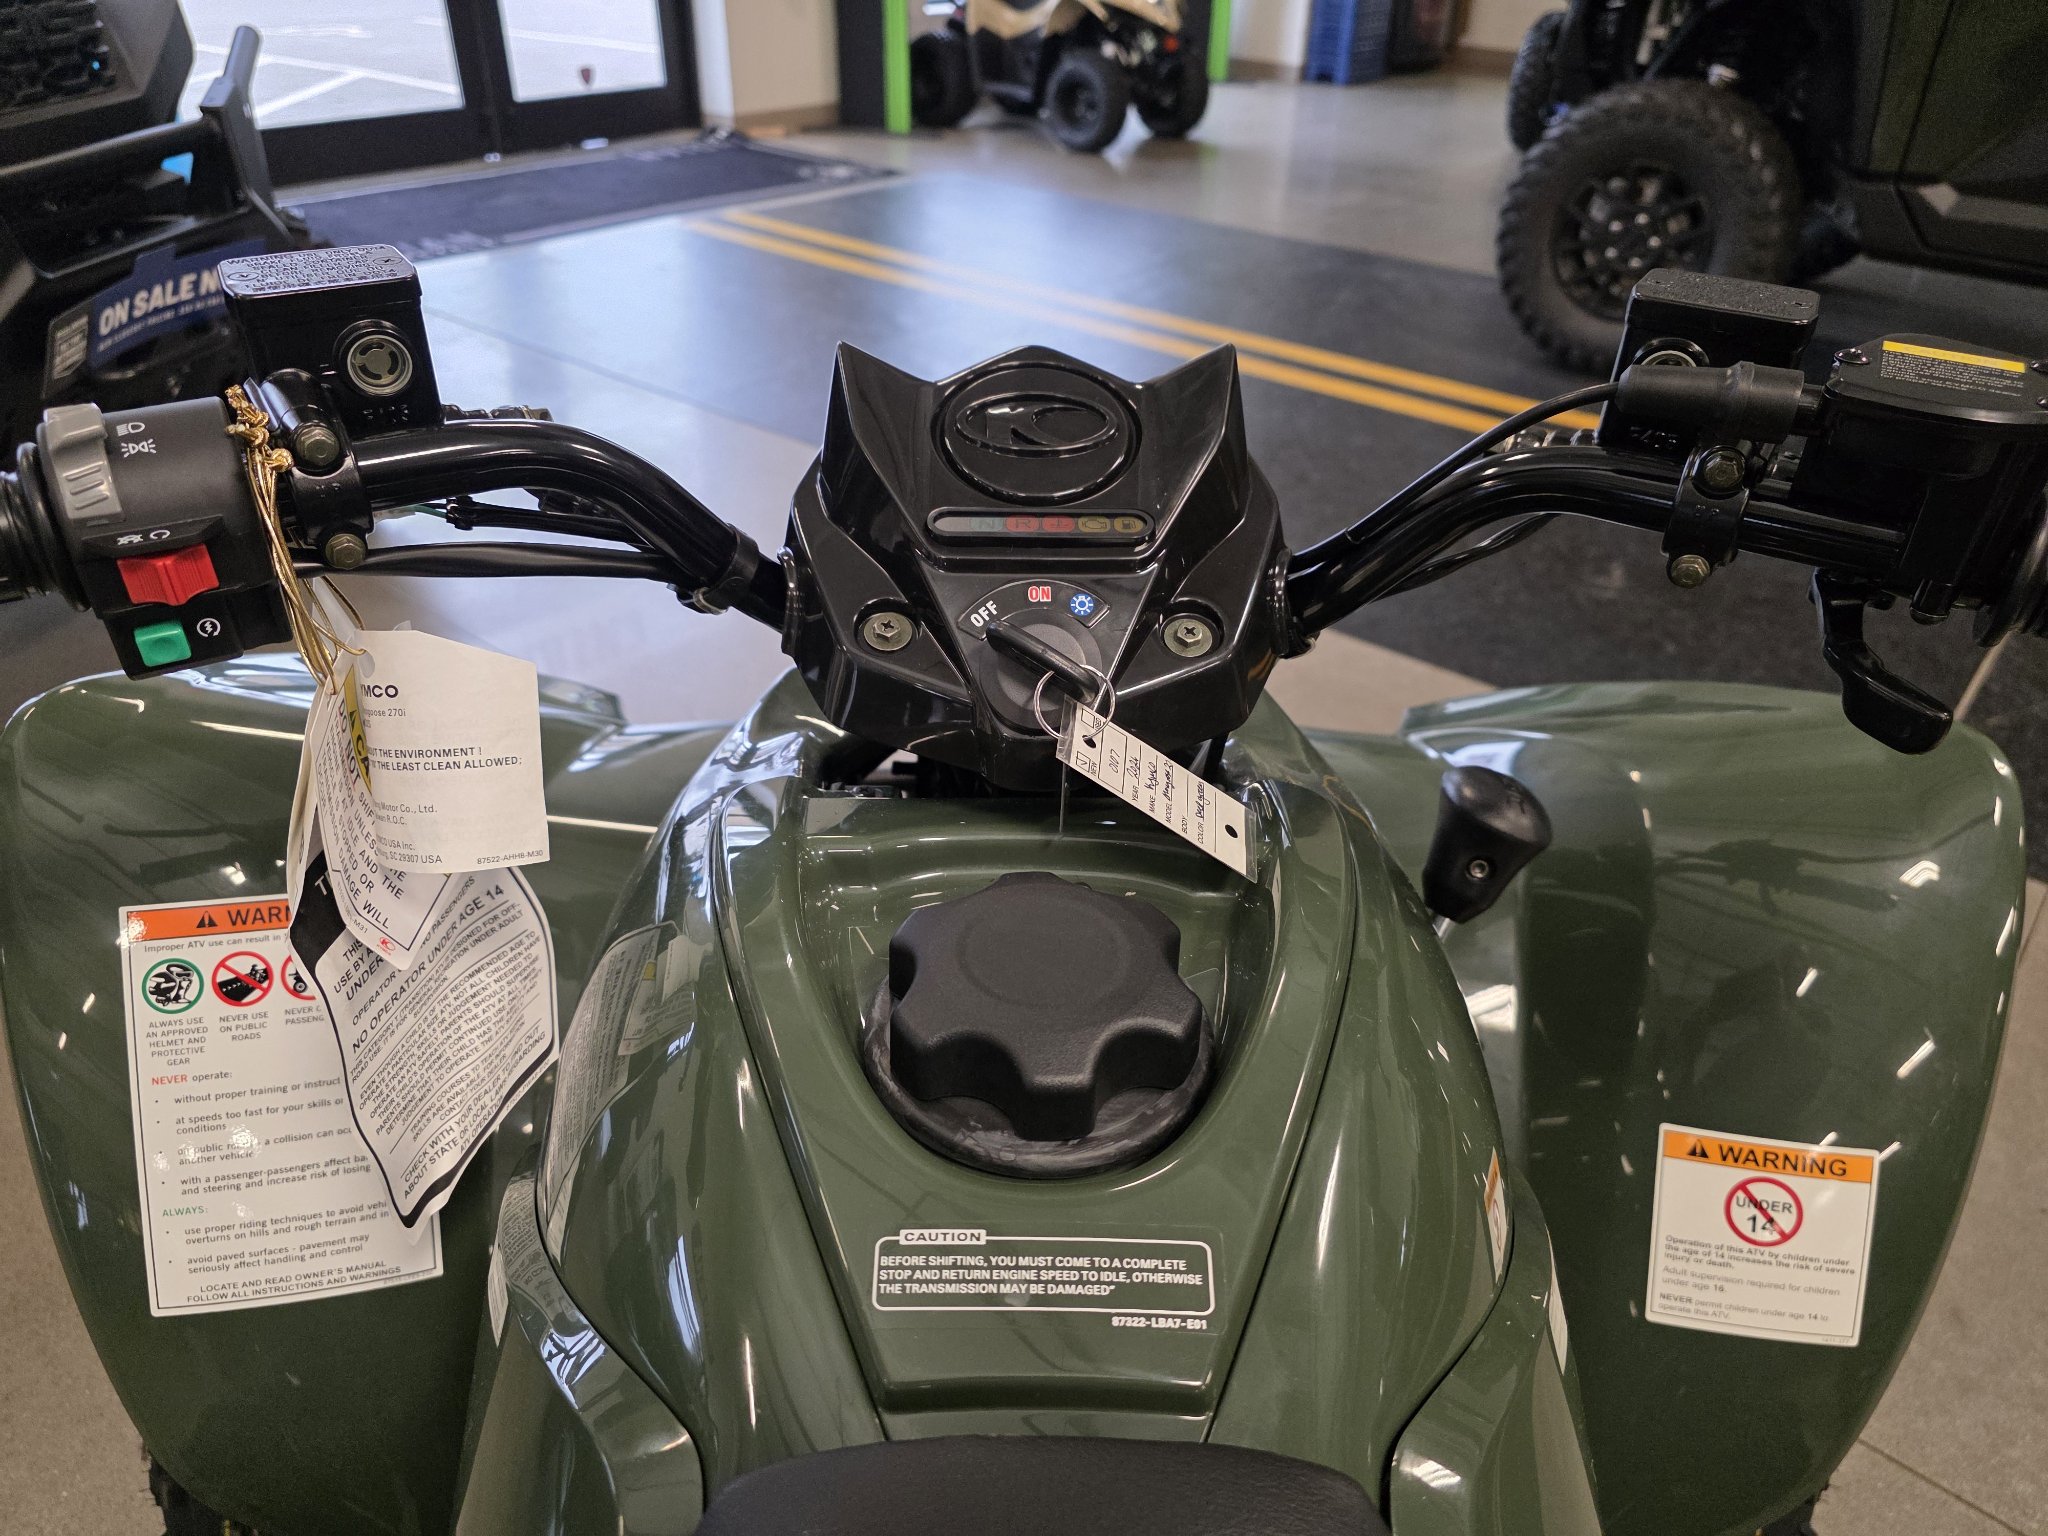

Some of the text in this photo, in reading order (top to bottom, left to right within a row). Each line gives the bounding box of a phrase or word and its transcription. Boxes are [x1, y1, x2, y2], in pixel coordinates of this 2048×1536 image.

[99, 298, 130, 336] ON
[133, 272, 197, 318] SALE
[1014, 518, 1031, 529] R
[1028, 586, 1051, 602] ON
[970, 600, 998, 627] OFF
[388, 709, 406, 717] 270i
[379, 749, 393, 758] THE
[395, 747, 475, 759] ENVIRONMENT
[378, 761, 390, 770] THE
[392, 762, 421, 771] LEAST
[423, 761, 460, 770] CLEAN
[400, 804, 416, 814] Co.,
[419, 804, 437, 813] Ltd.
[389, 839, 400, 848] USA
[422, 855, 442, 863] USA
[359, 851, 404, 899] AND THE
[360, 873, 375, 894] OR
[363, 900, 389, 929] WILL
[144, 943, 184, 952] Improper
[187, 940, 205, 948] ATV
[245, 934, 269, 943] result
[352, 885, 504, 1053] NO OPERATOR UNDER AGE 14
[333, 972, 353, 994] USE
[352, 973, 396, 1026] OPERATOR
[148, 1016, 204, 1028] ALWAYS USE
[219, 1010, 268, 1022] NEVER USE
[160, 1026, 208, 1036] APPROVED
[235, 1021, 267, 1030] PUBLIC
[149, 1035, 206, 1047] HELMET AND
[231, 1031, 261, 1041] ROADS
[151, 1045, 204, 1057] PROTECTIVE
[166, 1057, 190, 1065] GEAR
[151, 1071, 232, 1084] NEVER operate:
[174, 1093, 211, 1103] without
[214, 1090, 246, 1101] proper
[250, 1085, 288, 1095] training
[175, 1116, 184, 1124] at
[188, 1112, 222, 1125] speeds
[244, 1107, 262, 1116] fast
[265, 1106, 279, 1114] for
[282, 1103, 303, 1114] your
[307, 1099, 331, 1108] skills
[176, 1123, 226, 1134] conditions
[404, 1124, 456, 1182] CHECK WITH
[1718, 1144, 1848, 1177] WARNING
[180, 1175, 201, 1184] with
[214, 1162, 320, 1182] passenger-passengers
[323, 1156, 350, 1167] affect
[162, 1205, 207, 1216] ALWAYS:
[1736, 1195, 1793, 1214] UNDER
[185, 1231, 230, 1244] overturns
[248, 1225, 269, 1236] hills
[271, 1222, 290, 1233] and
[294, 1218, 321, 1231] rough
[324, 1216, 356, 1226] terrain
[359, 1210, 376, 1221] and
[204, 1223, 235, 1236] proper
[239, 1219, 267, 1229] riding
[270, 1212, 322, 1224] techniques
[338, 1203, 363, 1214] avoid
[904, 1232, 981, 1241] CAUTION
[1665, 1235, 1712, 1250] Operation
[1745, 1245, 1765, 1255] ATV
[1767, 1250, 1779, 1259] by
[1781, 1253, 1820, 1262] children
[1822, 1258, 1849, 1266] under
[880, 1256, 1187, 1270] BEFORE SHIFTING, YOU MUST COME TO A COMPLETE
[200, 1260, 386, 1292] LOCATE AND READ OWNER'S MANUAL
[879, 1270, 1203, 1285] STOP AND RETURN ENGINE SPEED TO IDLE, OTHERWISE
[186, 1288, 228, 1302] FOLLOW
[229, 1285, 248, 1296] ALL
[251, 1275, 323, 1293] INSTRUCTIONS
[325, 1272, 346, 1283] AND
[349, 1266, 400, 1280] WARNINGS
[879, 1284, 902, 1294] THE
[904, 1284, 997, 1294] TRANSMISSION
[1000, 1284, 1028, 1294] MAY
[1029, 1284, 1046, 1294] BE
